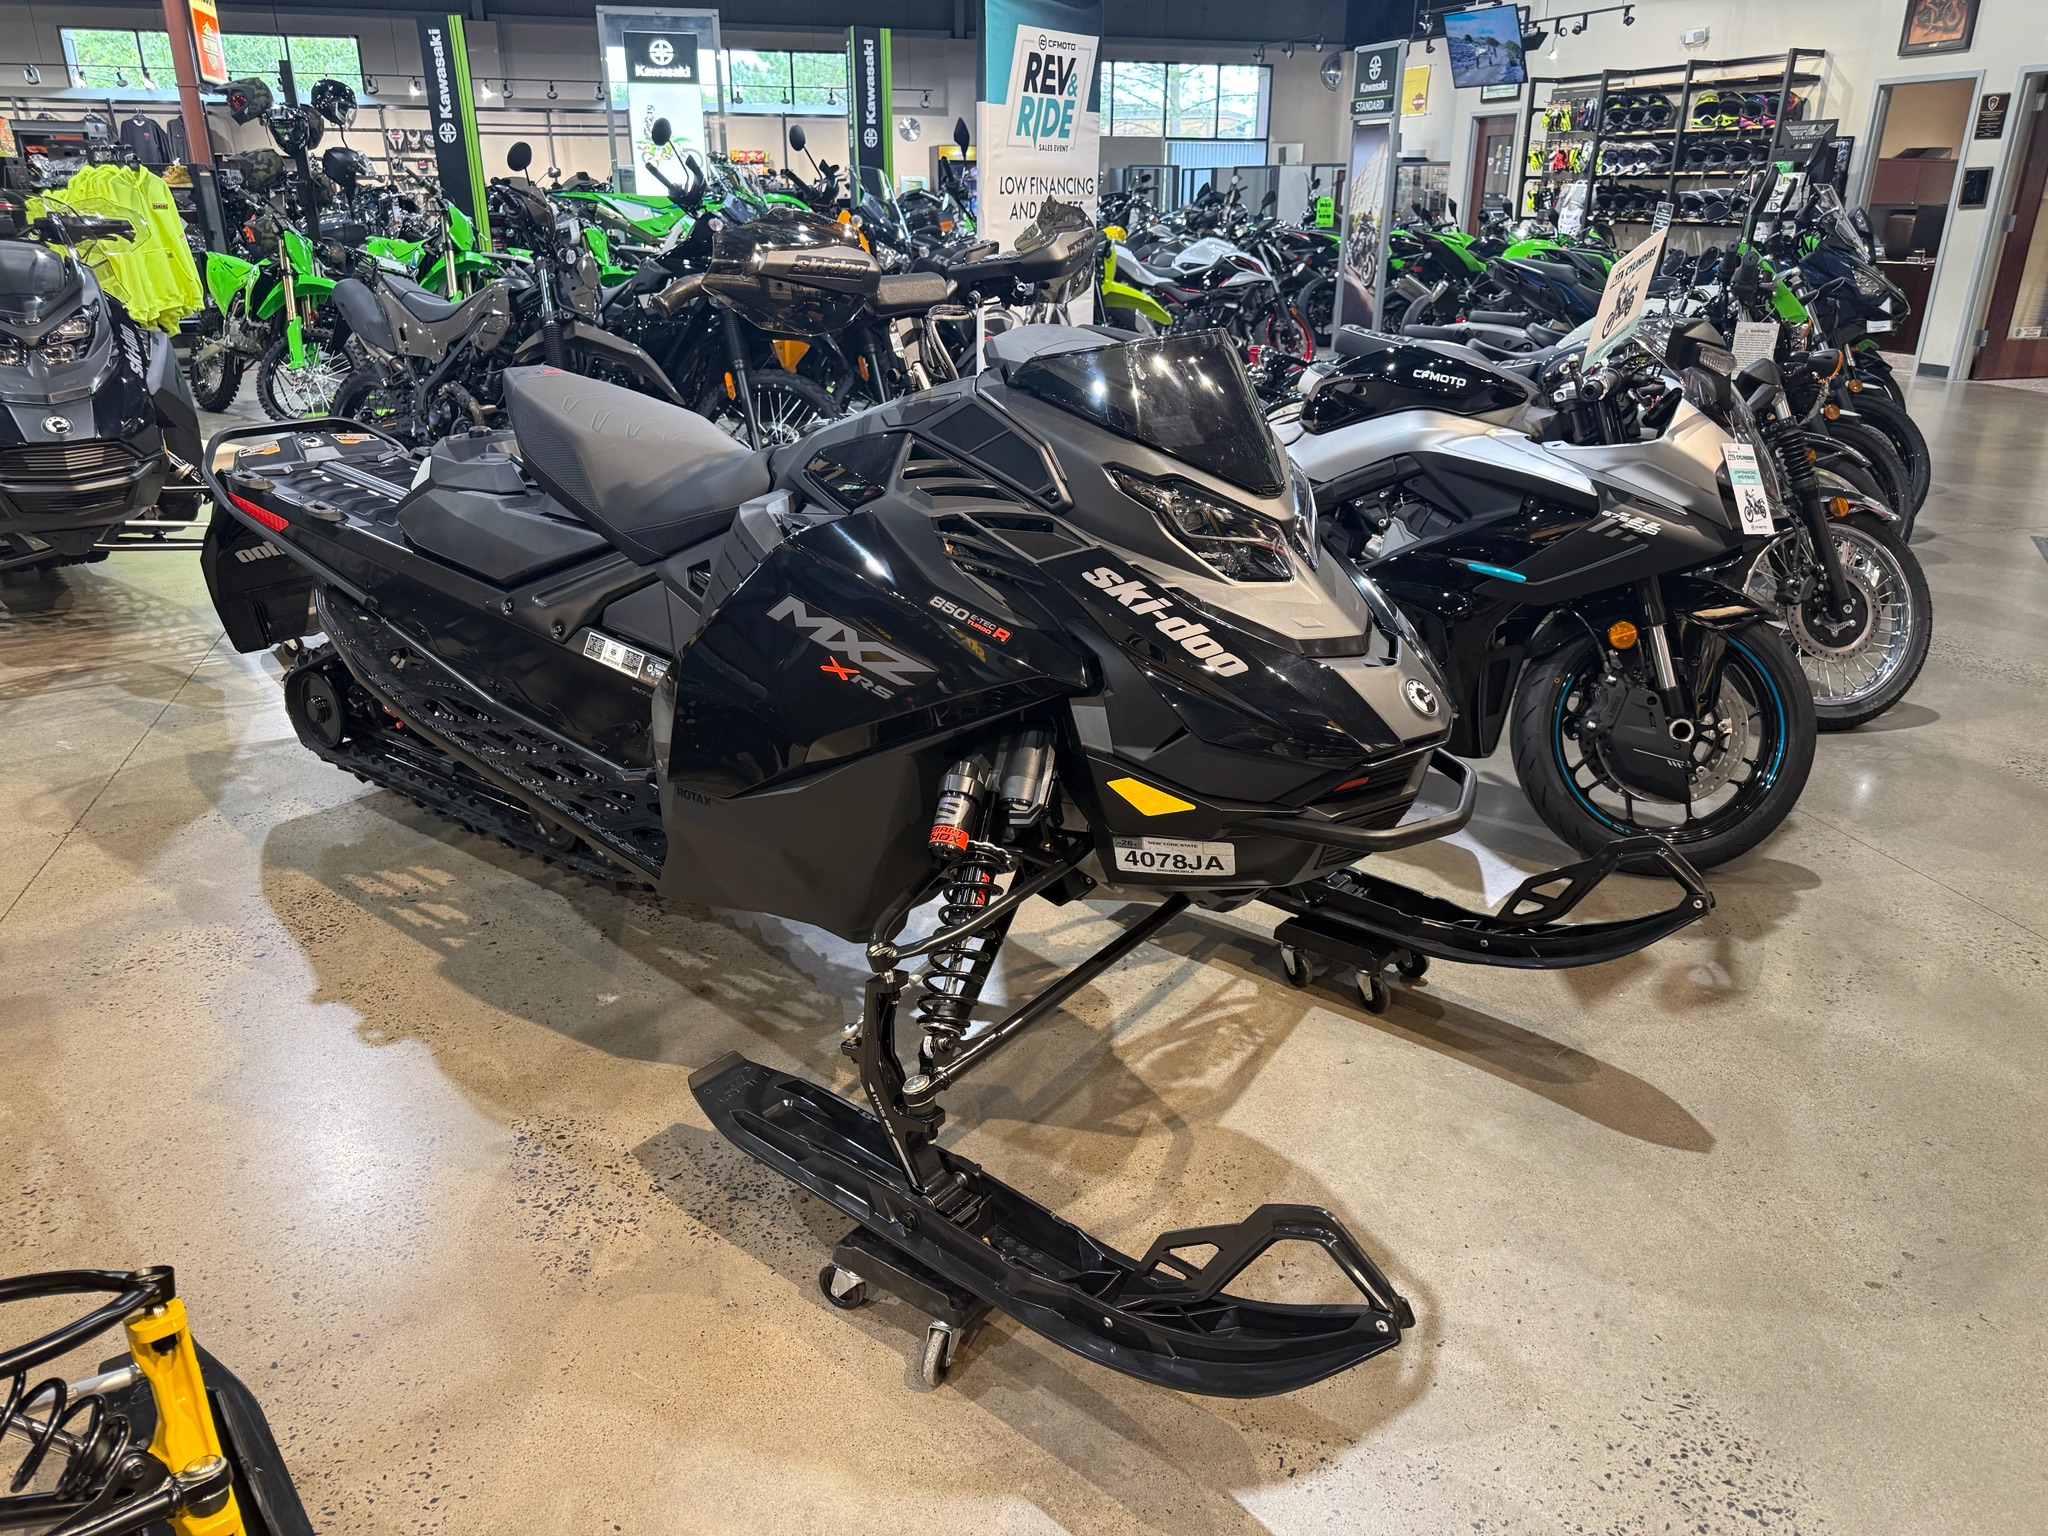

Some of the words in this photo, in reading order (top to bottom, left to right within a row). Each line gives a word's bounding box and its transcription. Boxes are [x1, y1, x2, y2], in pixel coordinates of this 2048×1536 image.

[1048, 40, 1076, 51] CFMOTO
[428, 29, 453, 119] Kawasaki
[634, 64, 691, 78] Kawasaki
[1023, 51, 1077, 96] REV
[1067, 72, 1078, 97] &
[863, 39, 876, 125] Kawasaki
[1360, 80, 1388, 93] Kawasaki
[1355, 99, 1385, 112] STANDARD
[1016, 95, 1076, 150] RIDE
[1039, 144, 1053, 152] SALES
[1054, 144, 1069, 152] EVENT
[999, 176, 1028, 195] LOW
[1030, 176, 1094, 195] FINANCING
[1009, 201, 1037, 220] AND
[1412, 369, 1467, 388] CFMOTO
[929, 595, 970, 621] 850
[967, 619, 992, 635] TURBO
[991, 627, 1011, 643] R
[970, 614, 997, 630] E-TEC
[766, 595, 938, 686] MXZ
[676, 786, 712, 807] ROTAX
[1124, 850, 1225, 871] 4078JA
